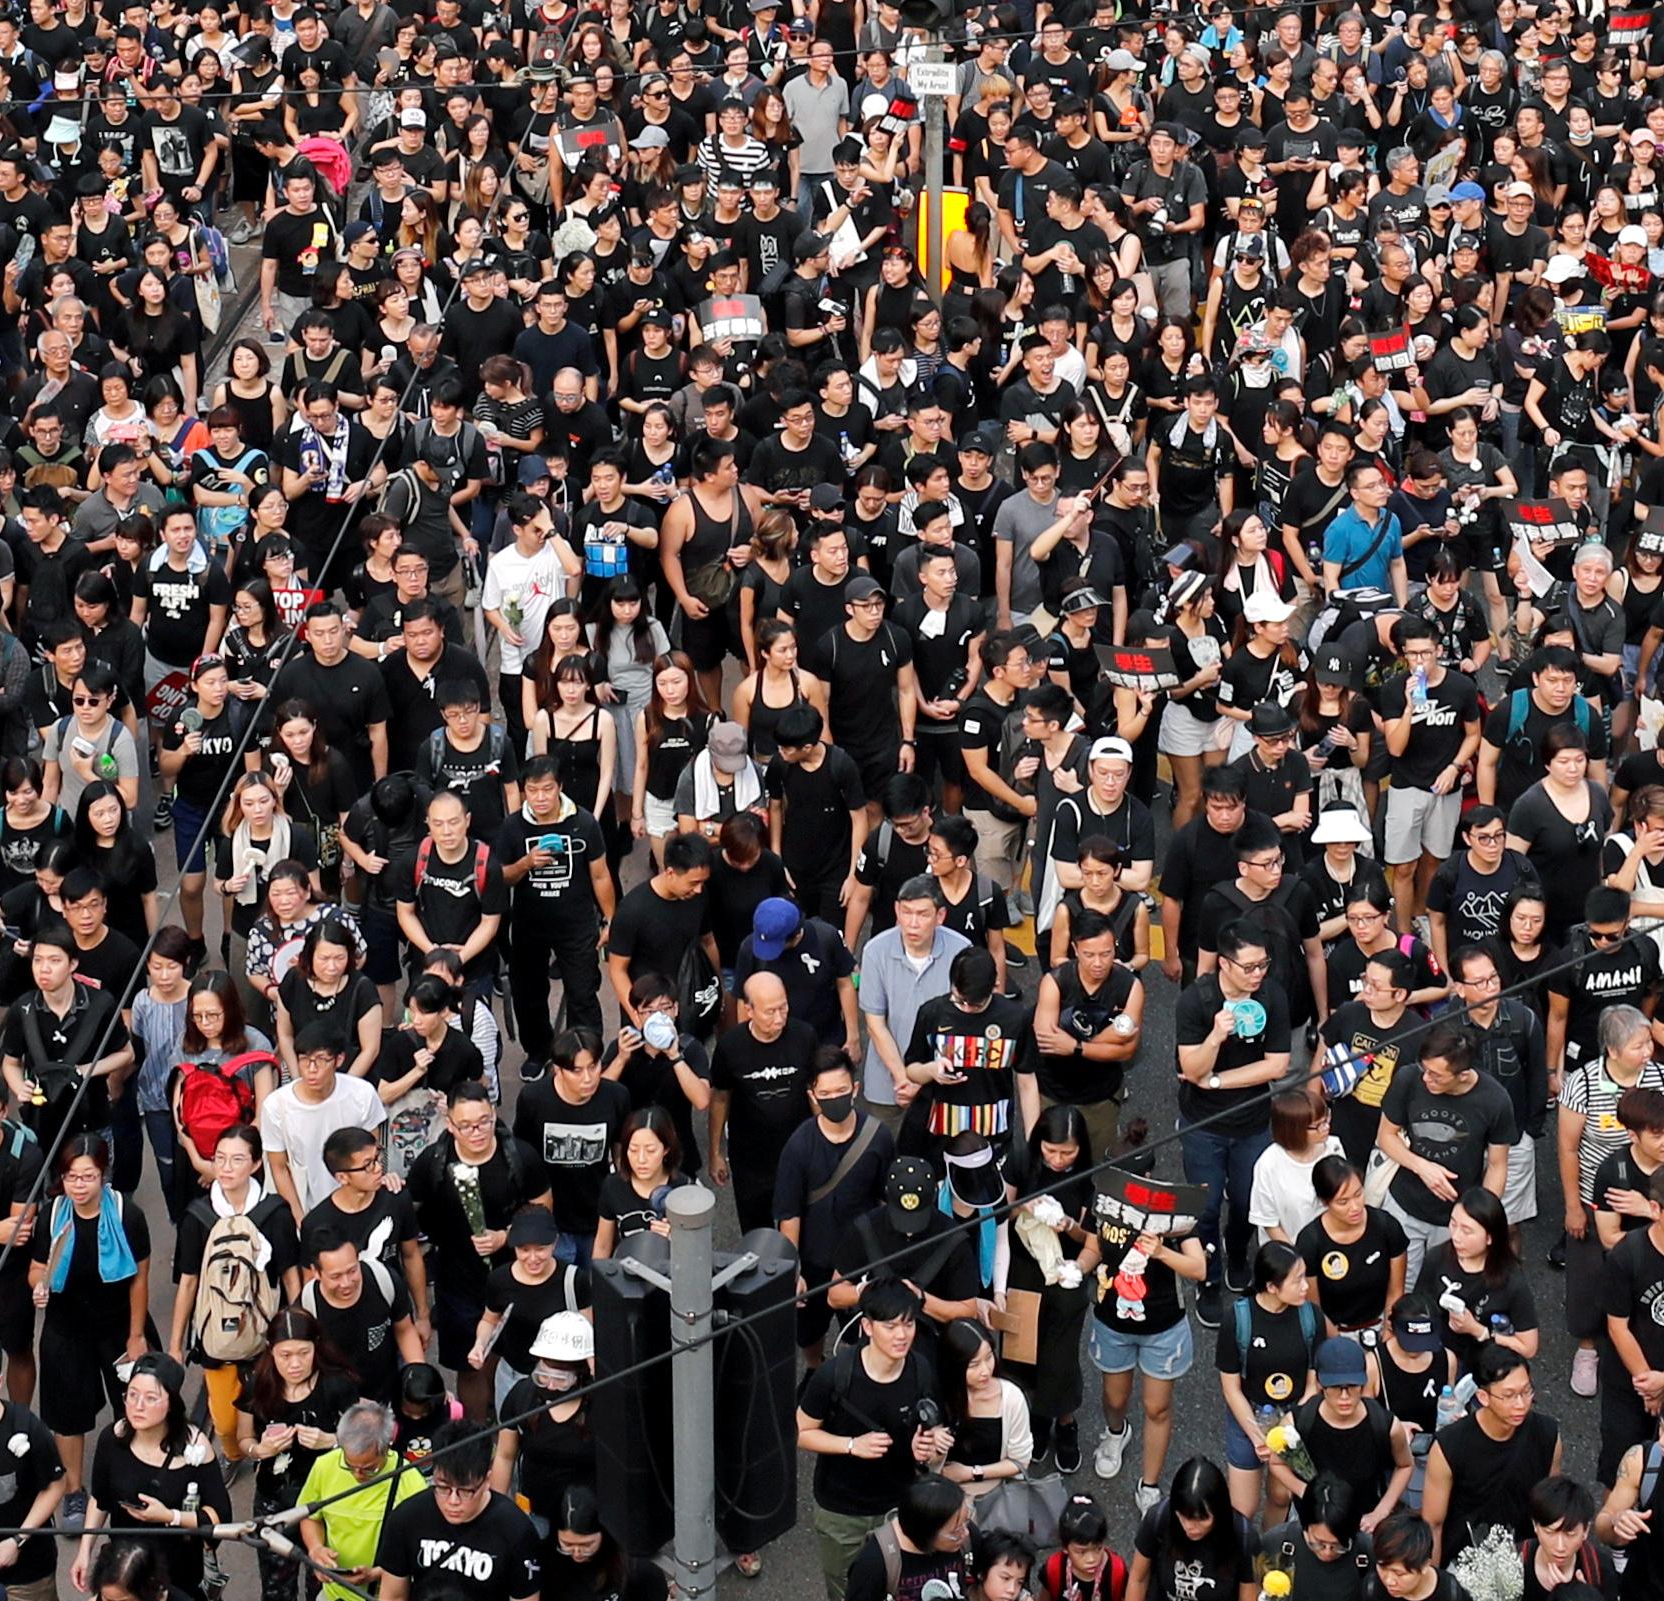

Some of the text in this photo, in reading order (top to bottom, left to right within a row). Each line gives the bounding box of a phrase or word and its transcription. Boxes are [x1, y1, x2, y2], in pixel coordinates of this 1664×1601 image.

[915, 67, 950, 78] Extradite
[152, 583, 200, 601] FRESH
[1113, 653, 1155, 674] 學生
[1585, 965, 1643, 992] AMANI
[1352, 1034, 1400, 1062] CAUON
[1420, 1109, 1464, 1128] GOOSE
[419, 1538, 494, 1582] TOKYO
